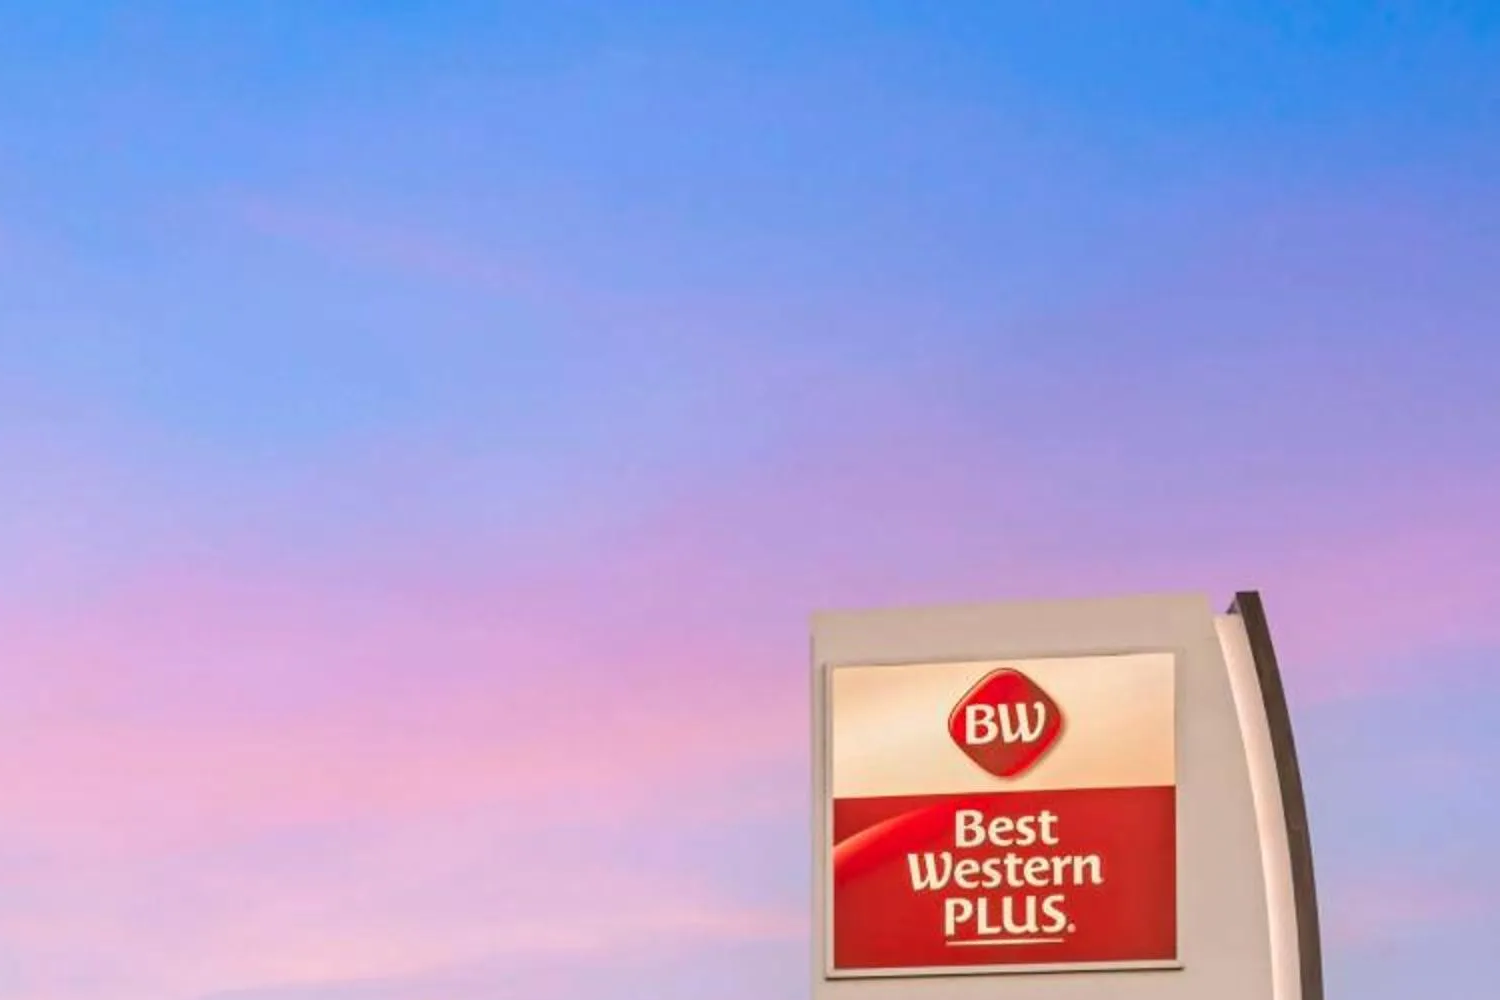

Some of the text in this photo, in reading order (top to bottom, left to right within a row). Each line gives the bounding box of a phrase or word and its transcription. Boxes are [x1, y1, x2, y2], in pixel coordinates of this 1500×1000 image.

[964, 701, 1046, 745] BW
[955, 808, 1059, 848] Best
[907, 851, 1104, 891] Western
